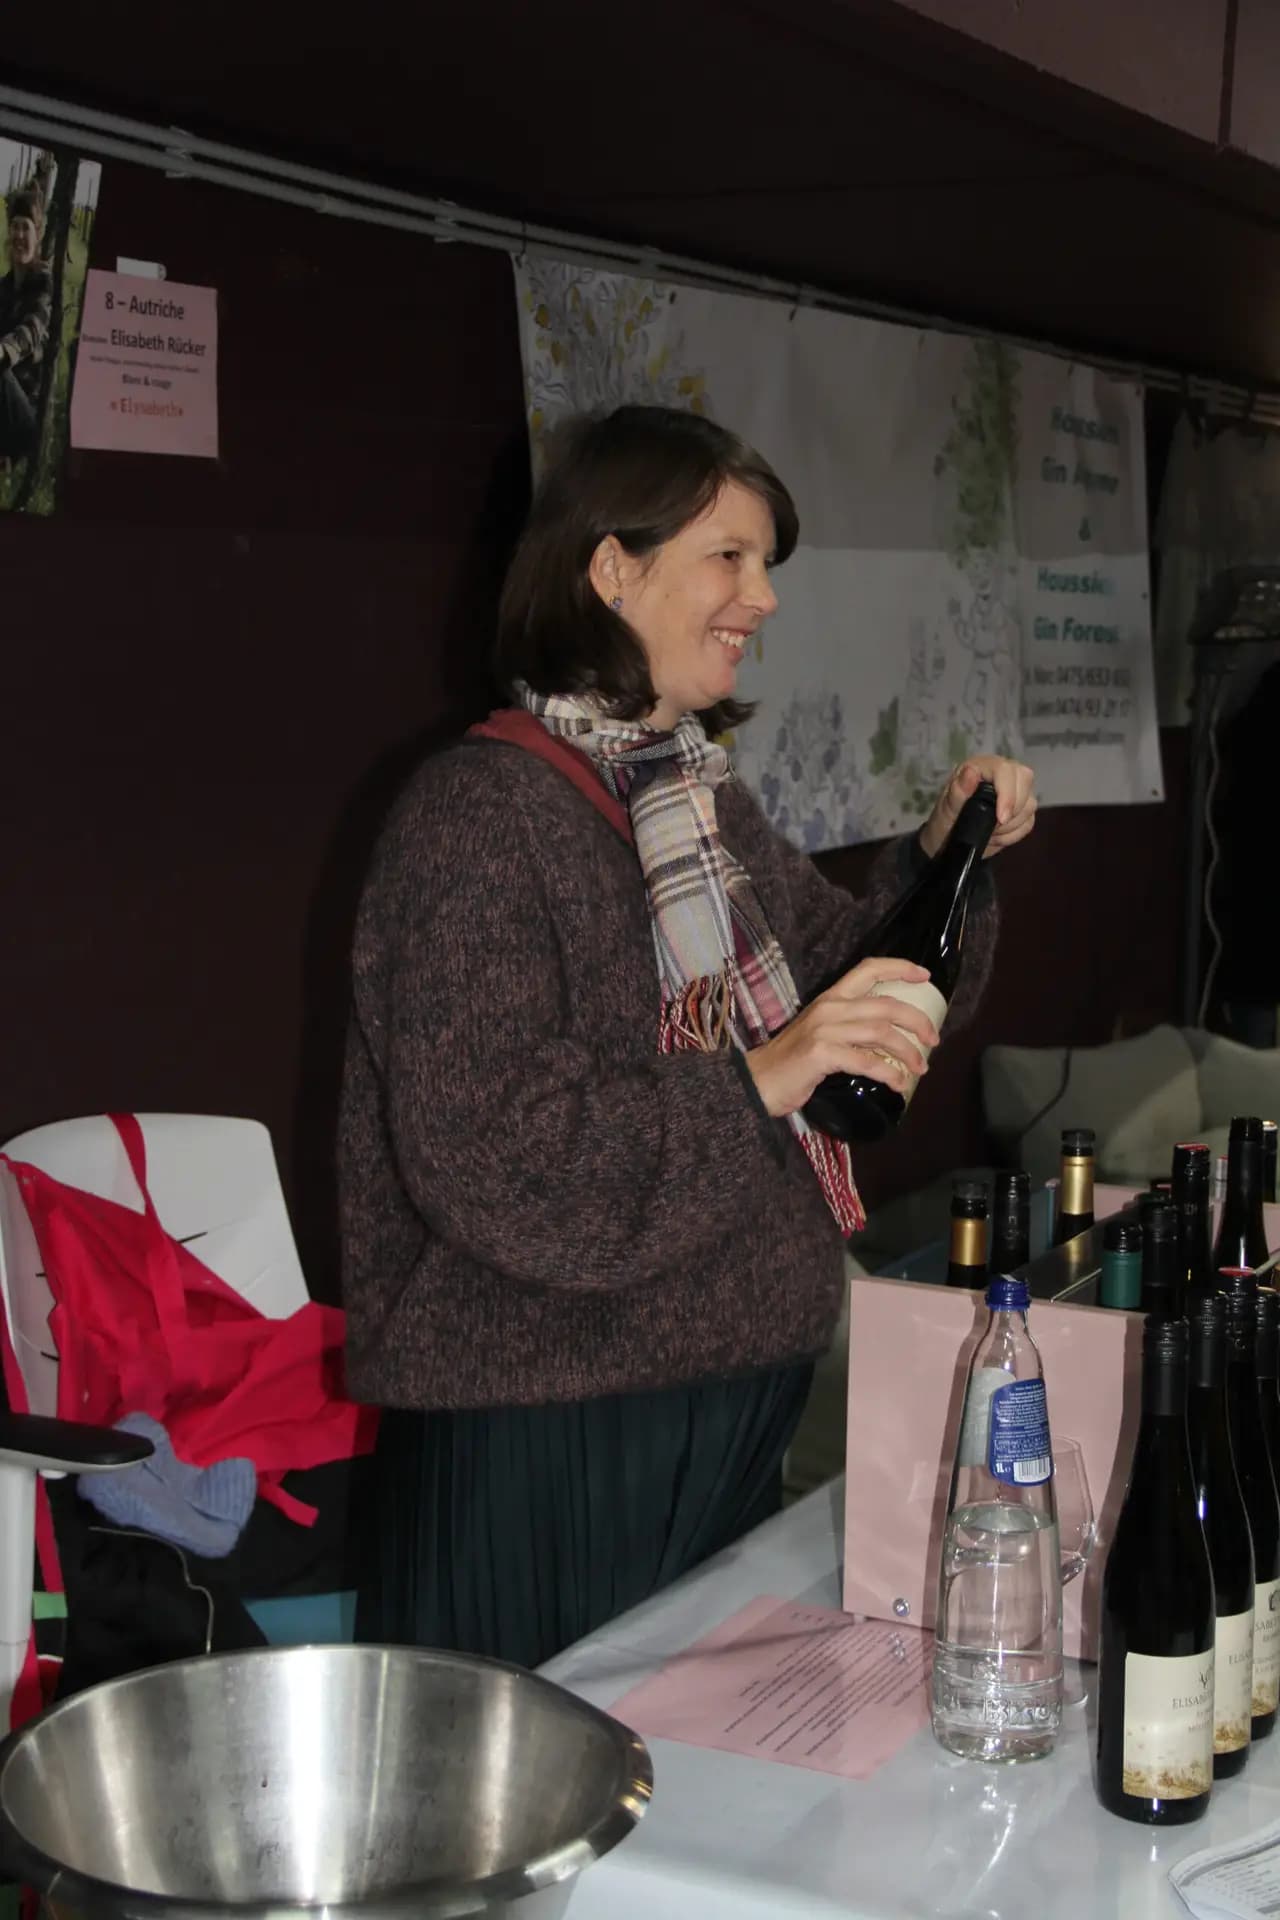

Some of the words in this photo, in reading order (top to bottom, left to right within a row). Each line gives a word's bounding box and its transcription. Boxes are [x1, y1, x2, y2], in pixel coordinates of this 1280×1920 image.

[105, 291, 115, 310] 8
[129, 295, 185, 320] Autriche
[111, 329, 165, 352] Elisabeth
[167, 335, 207, 357] Rücker
